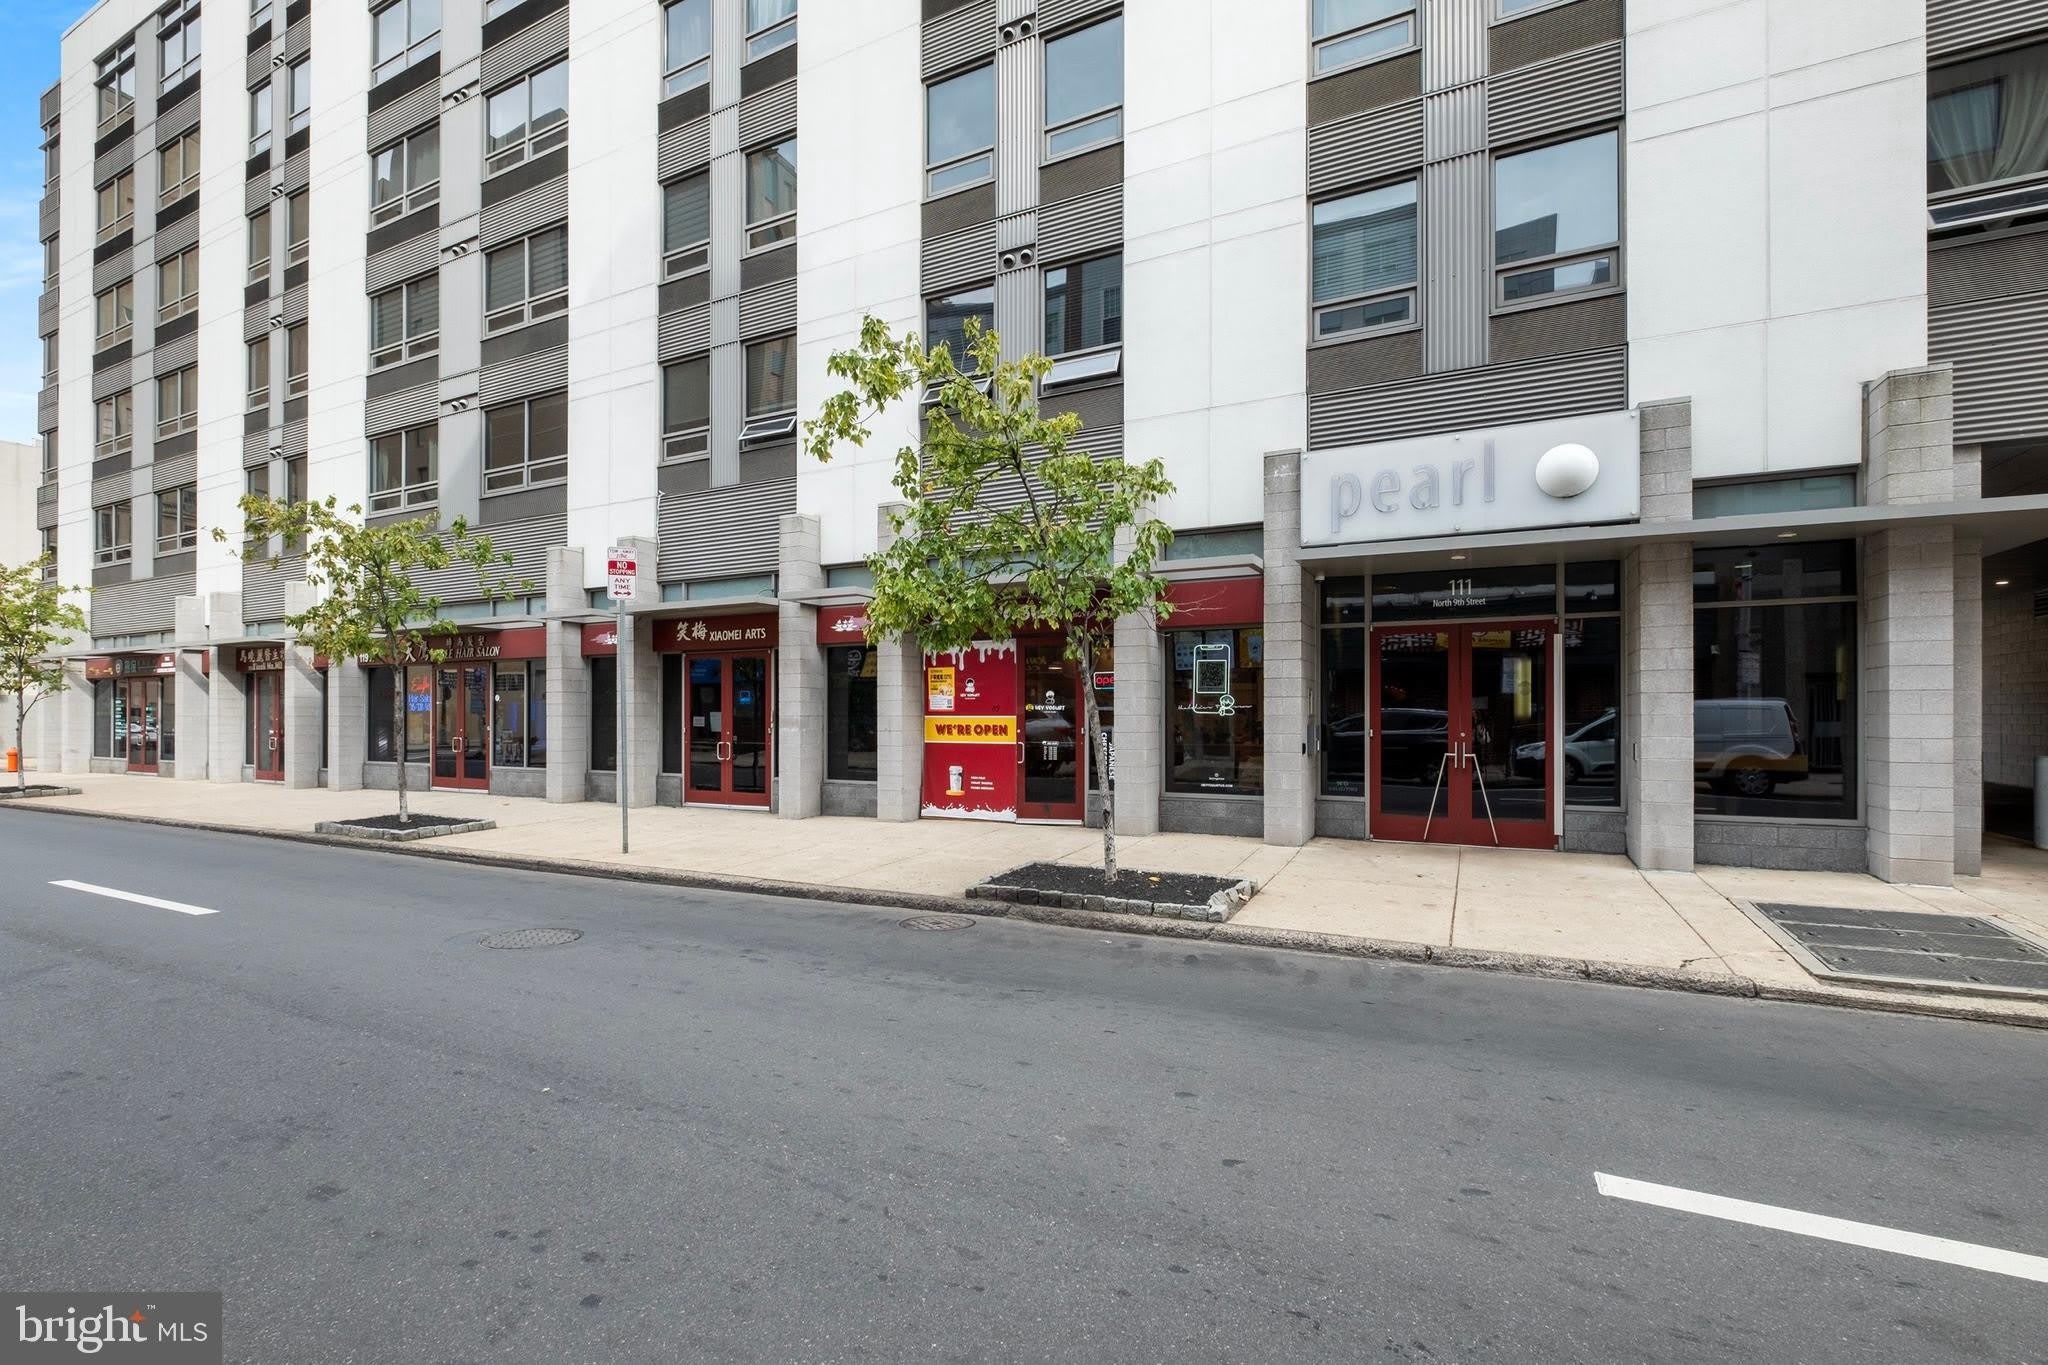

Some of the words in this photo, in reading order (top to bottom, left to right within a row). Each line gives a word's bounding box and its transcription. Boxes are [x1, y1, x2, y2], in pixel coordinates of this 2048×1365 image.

[1328, 439, 1497, 534] pearl
[617, 561, 627, 570] NO
[1448, 579, 1472, 596] 111
[1432, 599, 1452, 608] North
[1452, 598, 1465, 607] 9th
[1466, 597, 1486, 606] Street
[709, 628, 742, 642] XIAOMEI
[745, 627, 767, 640] ARTS
[455, 648, 474, 660] HAIR
[476, 646, 500, 658] SALON
[1096, 675, 1114, 685] ope
[935, 723, 973, 736] WE'RE
[973, 724, 1008, 737] OPEN
[1108, 741, 1116, 780] JAPANESE
